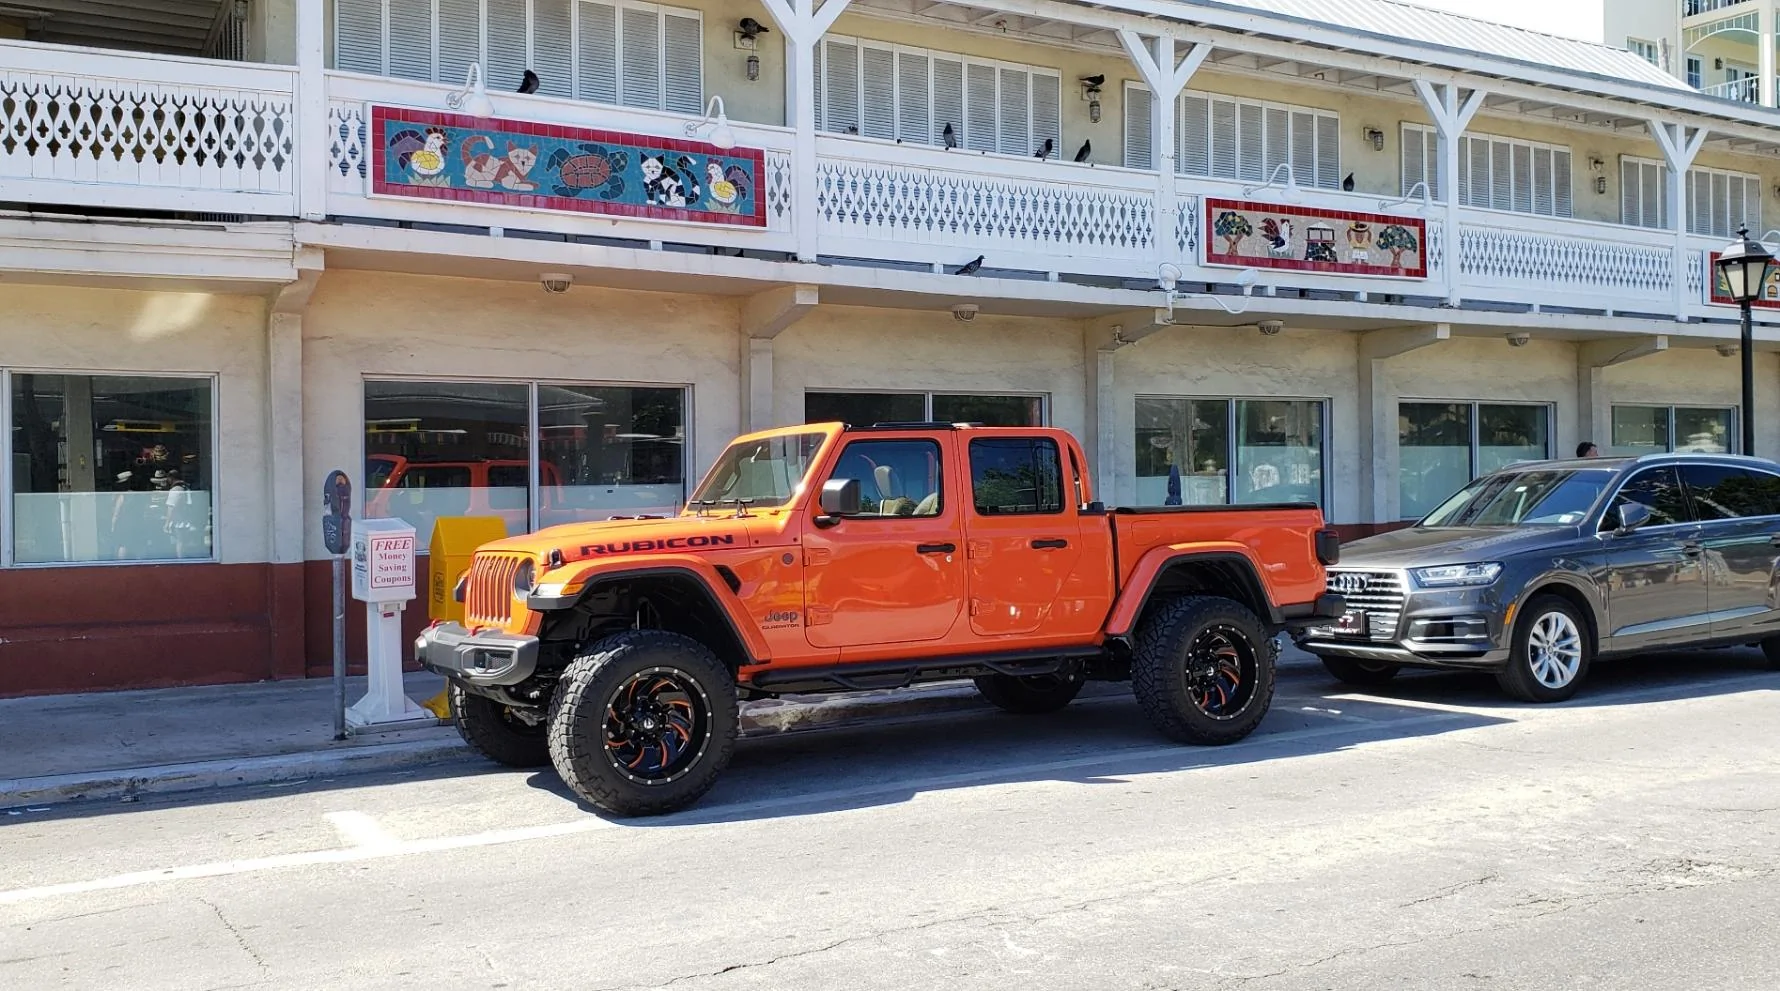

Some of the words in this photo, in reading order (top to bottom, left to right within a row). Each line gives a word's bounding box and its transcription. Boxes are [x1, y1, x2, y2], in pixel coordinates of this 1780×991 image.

[375, 540, 411, 551] FREE
[580, 534, 733, 556] RUBICON
[378, 564, 407, 572] Saving
[374, 576, 411, 584] Coupons
[764, 609, 799, 623] Jeep
